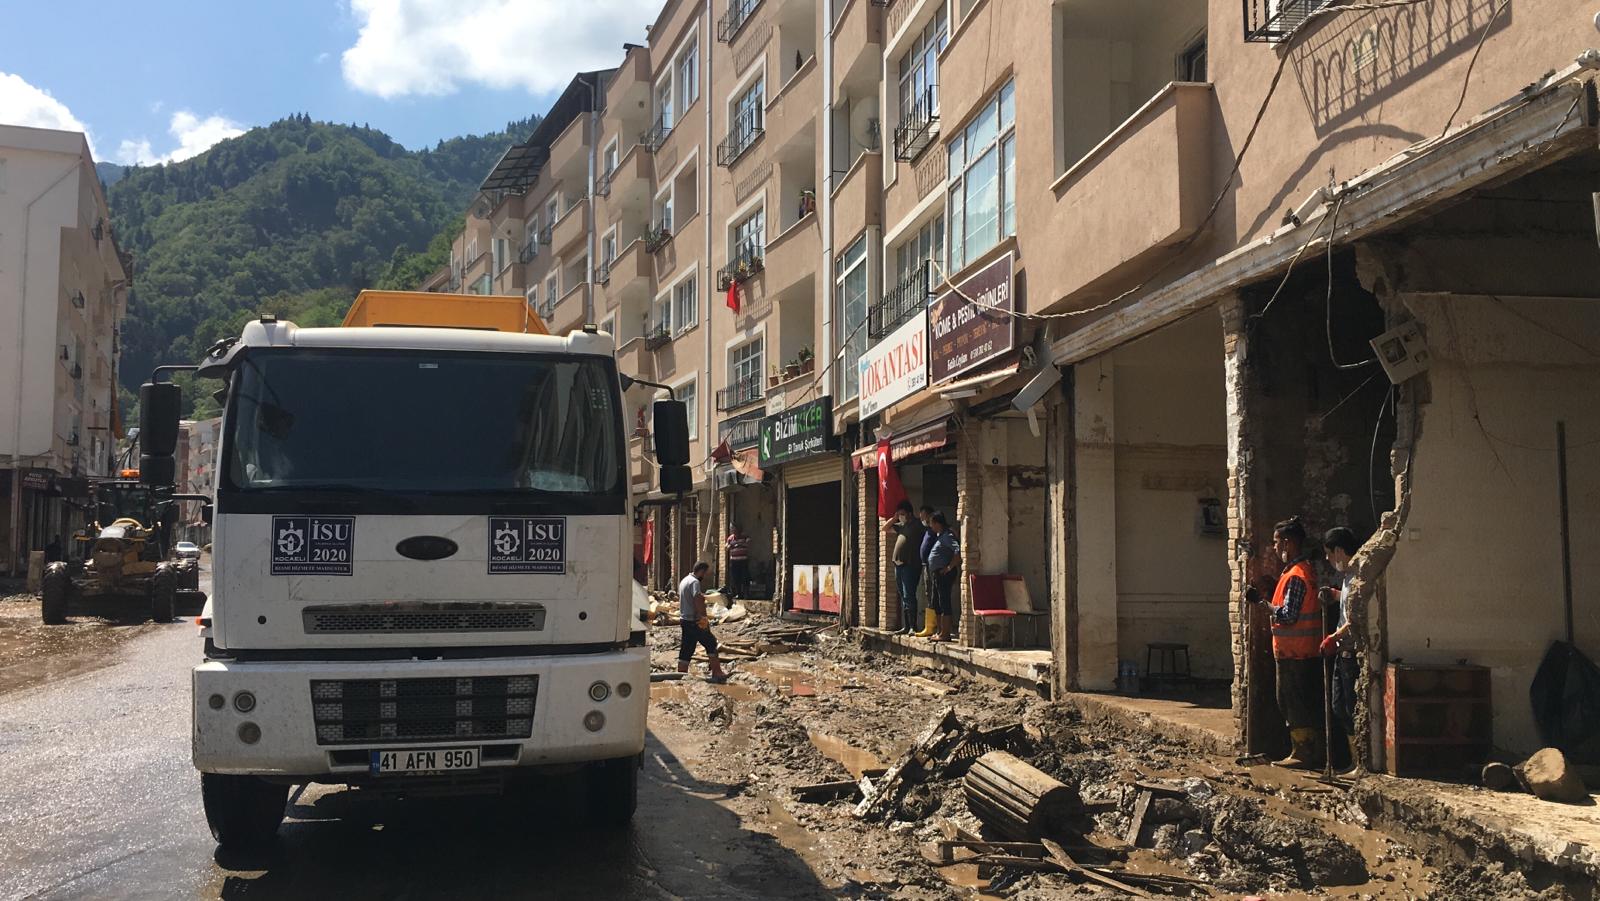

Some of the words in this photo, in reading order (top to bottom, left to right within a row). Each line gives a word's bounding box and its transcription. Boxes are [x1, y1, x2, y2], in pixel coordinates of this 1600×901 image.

[952, 313, 957, 330] &
[861, 329, 924, 400] LOKANTASI
[312, 519, 350, 541] İSU
[527, 520, 562, 541] İSU
[313, 548, 347, 562] 2020
[528, 548, 560, 561] 2020
[381, 753, 397, 770] 41
[406, 751, 436, 769] AFN
[444, 750, 473, 768] 950
